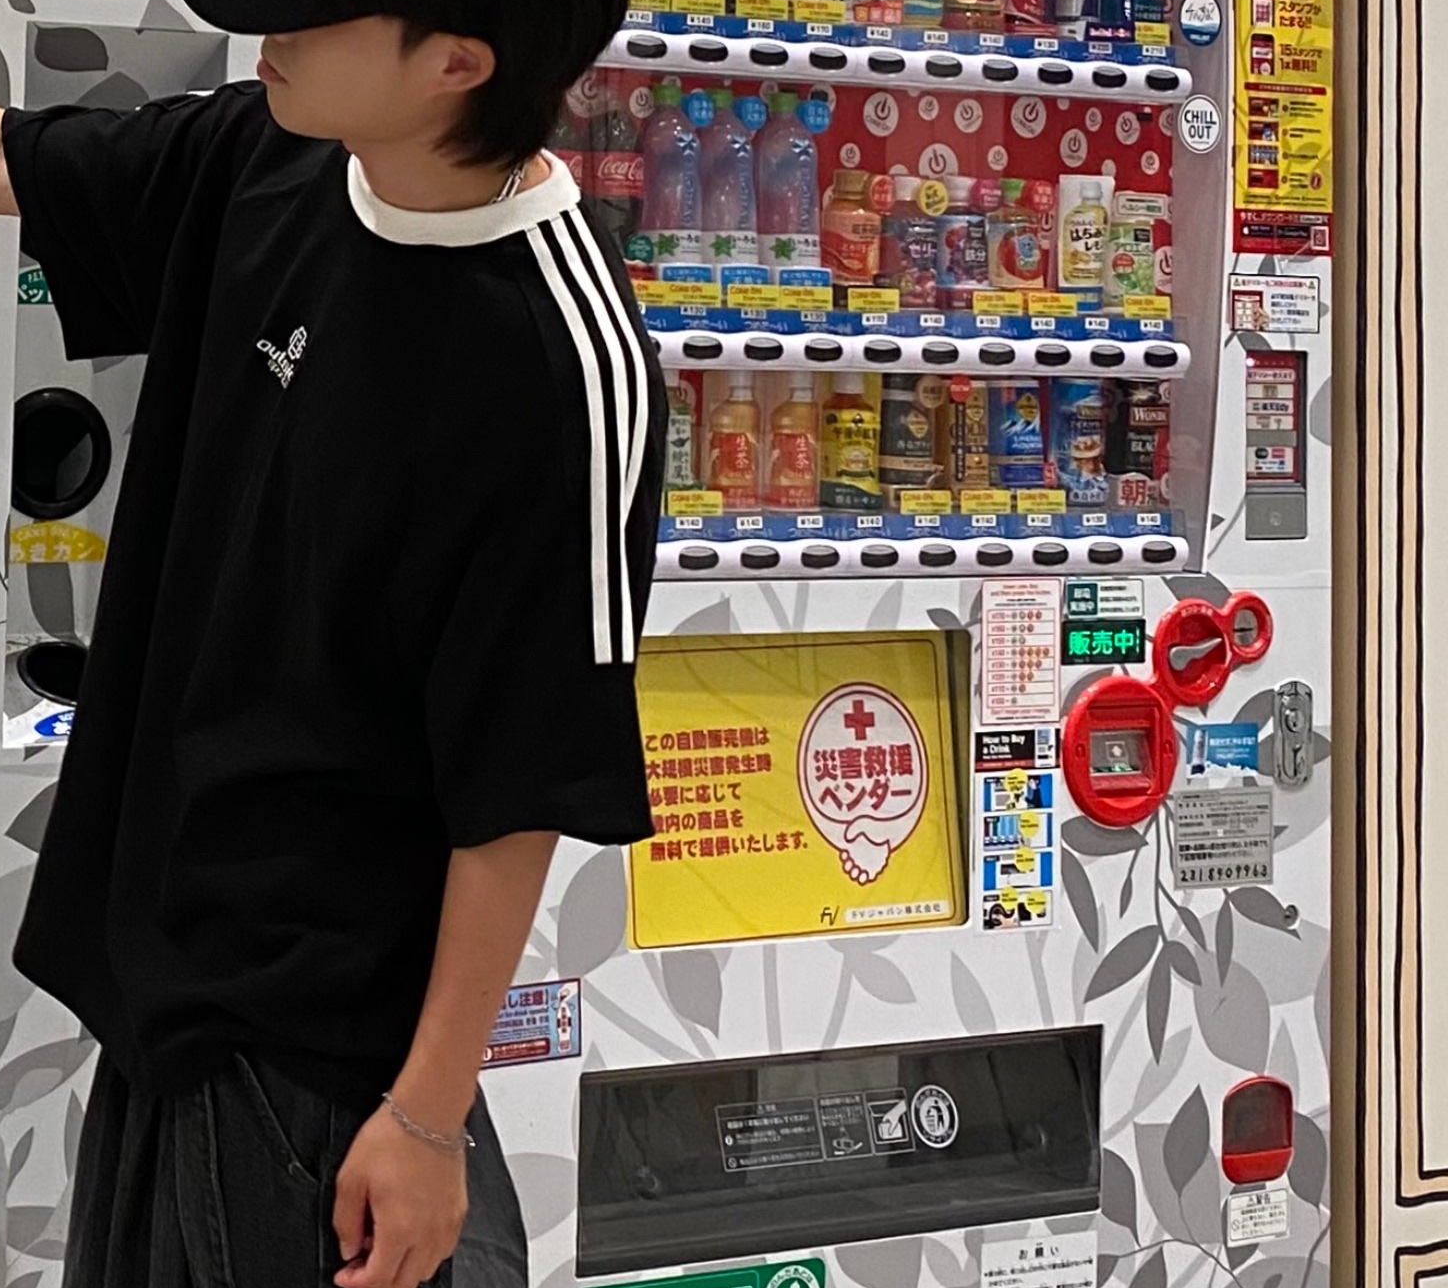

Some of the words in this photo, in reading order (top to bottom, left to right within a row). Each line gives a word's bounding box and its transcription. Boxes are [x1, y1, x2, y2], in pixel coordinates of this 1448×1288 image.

[1184, 109, 1217, 126] CHILL
[1188, 125, 1211, 140] OUT
[1068, 629, 1135, 656] 販売中
[645, 727, 770, 752] この自動販売機は
[982, 735, 1000, 744] How
[1011, 734, 1025, 745] Buy
[645, 753, 772, 780] 大規模災害発生時
[813, 744, 914, 781] 災害救援
[650, 781, 742, 807] 必要に応じて
[818, 780, 913, 812] ベンダー
[650, 831, 808, 861] 無料で提供いたします。
[1019, 1244, 1060, 1260] お願い
